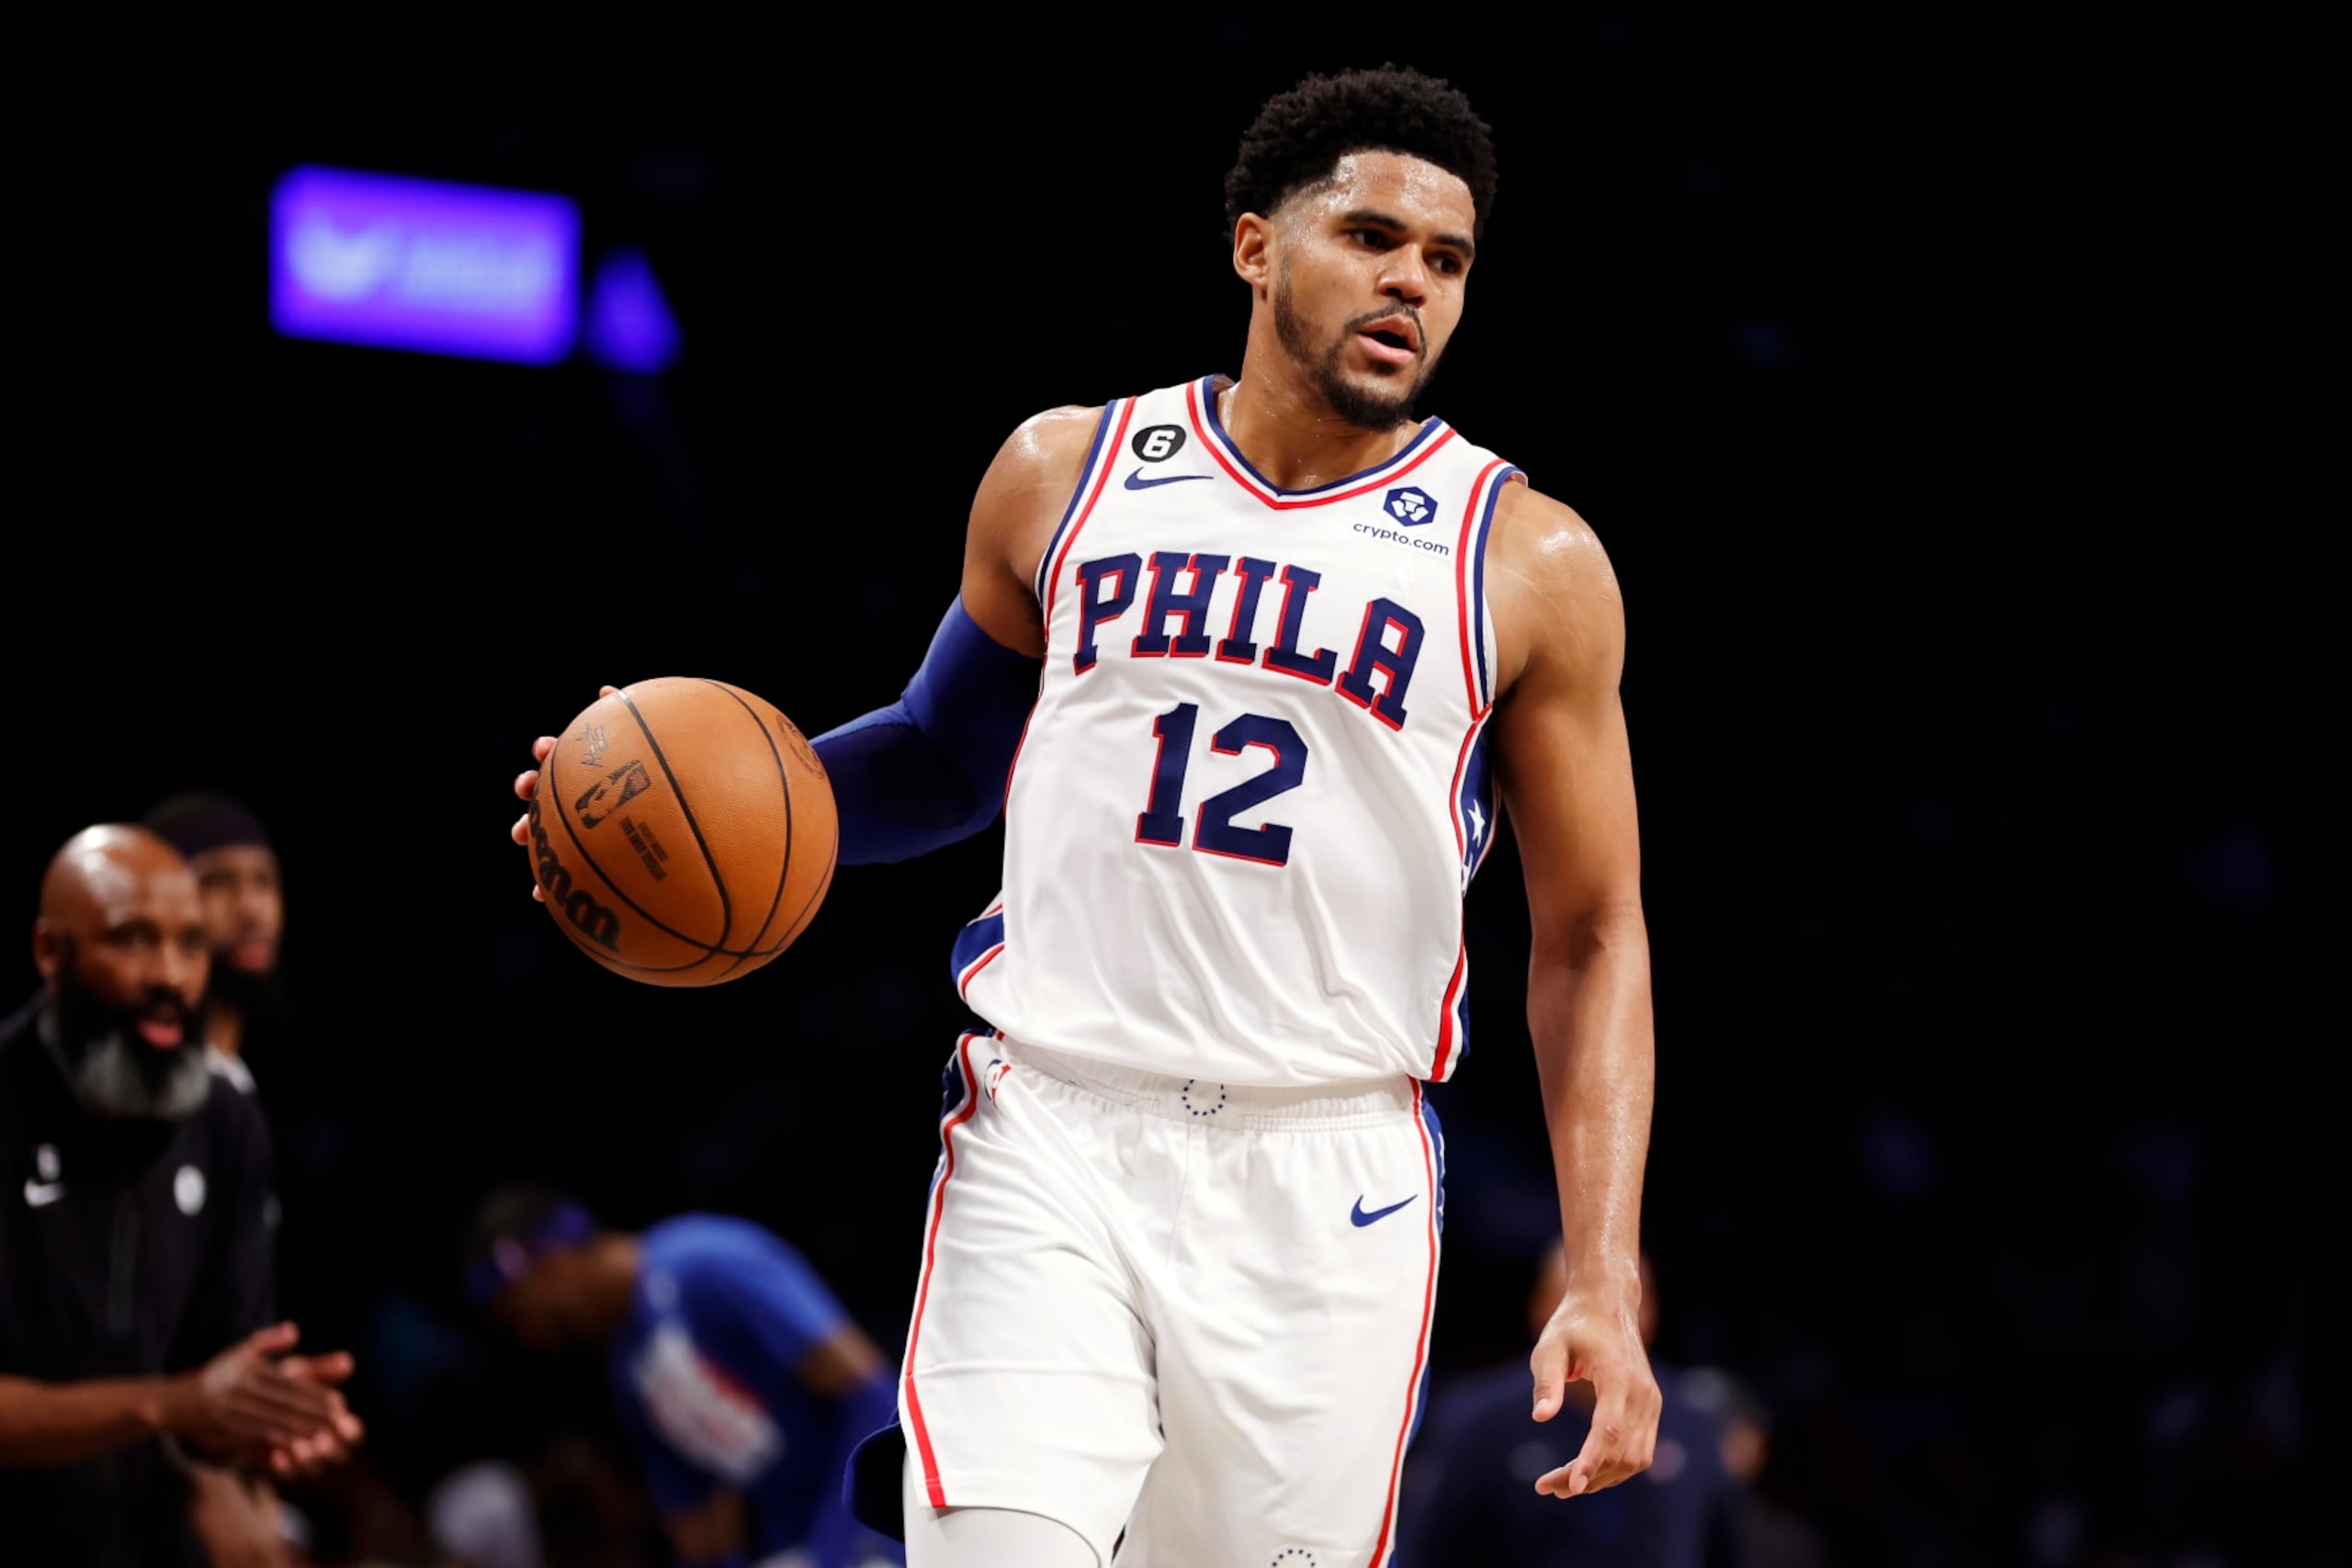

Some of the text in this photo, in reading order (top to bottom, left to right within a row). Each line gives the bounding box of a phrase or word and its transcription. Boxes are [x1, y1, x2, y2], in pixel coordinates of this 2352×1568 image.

[1142, 429, 1176, 457] 6
[1352, 523, 1450, 556] crypto.com
[1073, 551, 1425, 732] PHILA
[1135, 702, 1308, 867] 12
